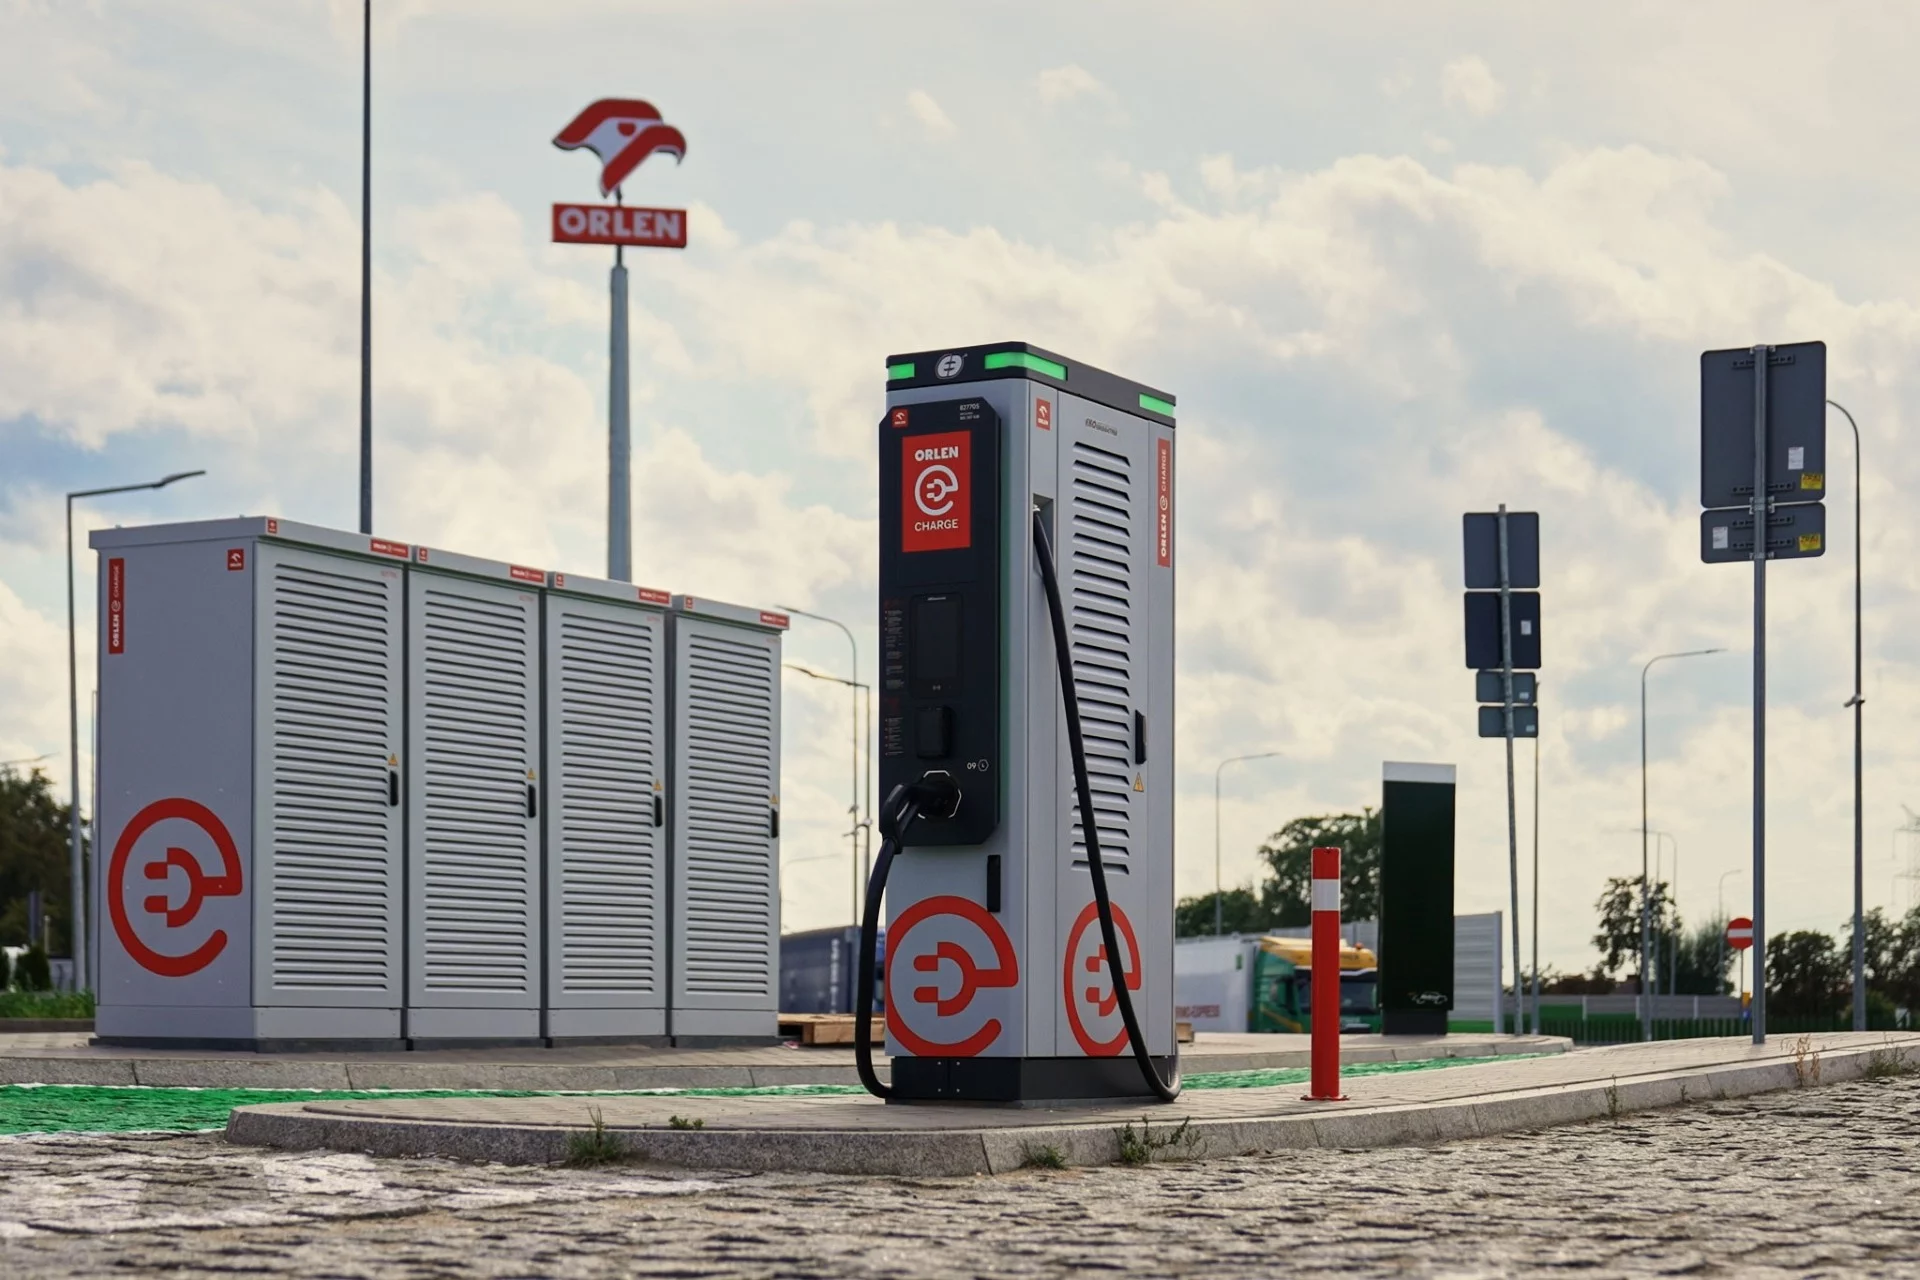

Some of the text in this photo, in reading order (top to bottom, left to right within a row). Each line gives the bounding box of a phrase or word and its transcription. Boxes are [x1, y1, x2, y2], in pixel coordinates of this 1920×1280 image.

[559, 207, 680, 239] ORLEN
[914, 446, 959, 462] ORLEN
[914, 519, 959, 532] CHARGE
[112, 614, 120, 647] ORLEN
